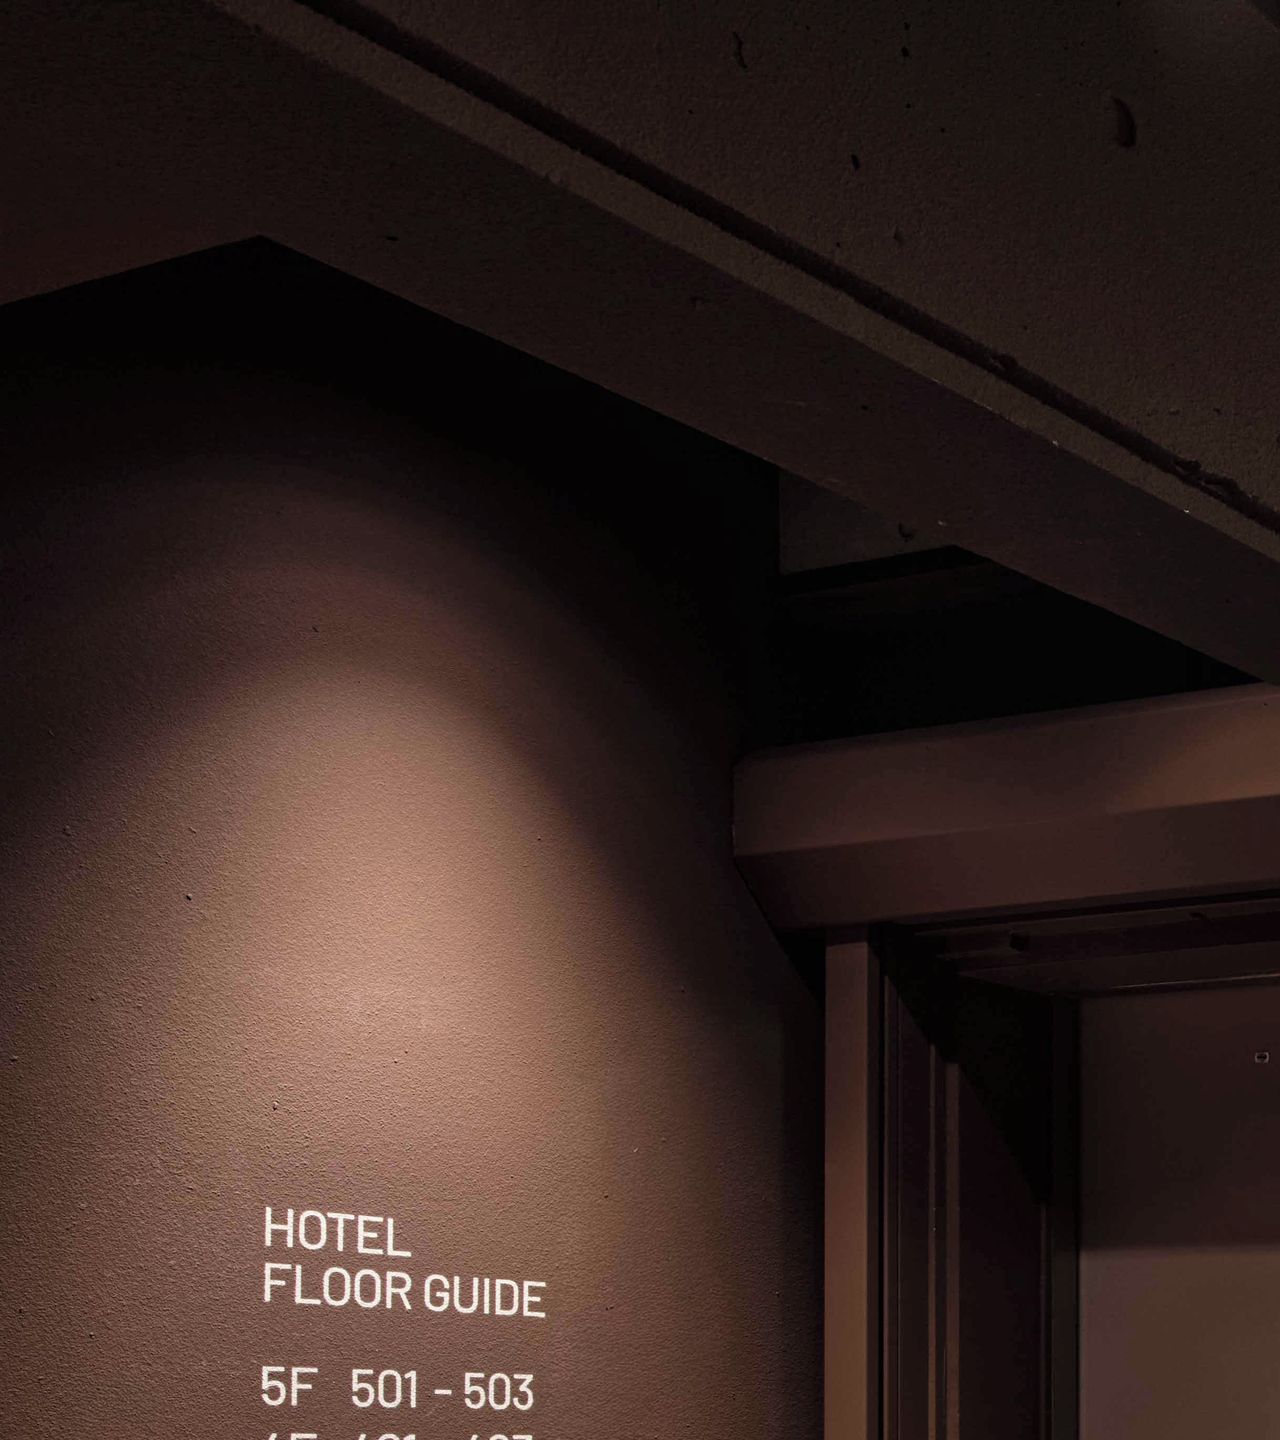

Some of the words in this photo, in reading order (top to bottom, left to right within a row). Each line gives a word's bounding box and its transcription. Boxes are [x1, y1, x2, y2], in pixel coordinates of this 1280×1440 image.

[265, 1207, 411, 1258] HOTEL
[264, 1262, 412, 1310] FLOOR
[424, 1273, 547, 1318] GUIDE
[261, 1366, 318, 1406] 5F
[351, 1369, 417, 1408] 501
[464, 1373, 534, 1410] 503
